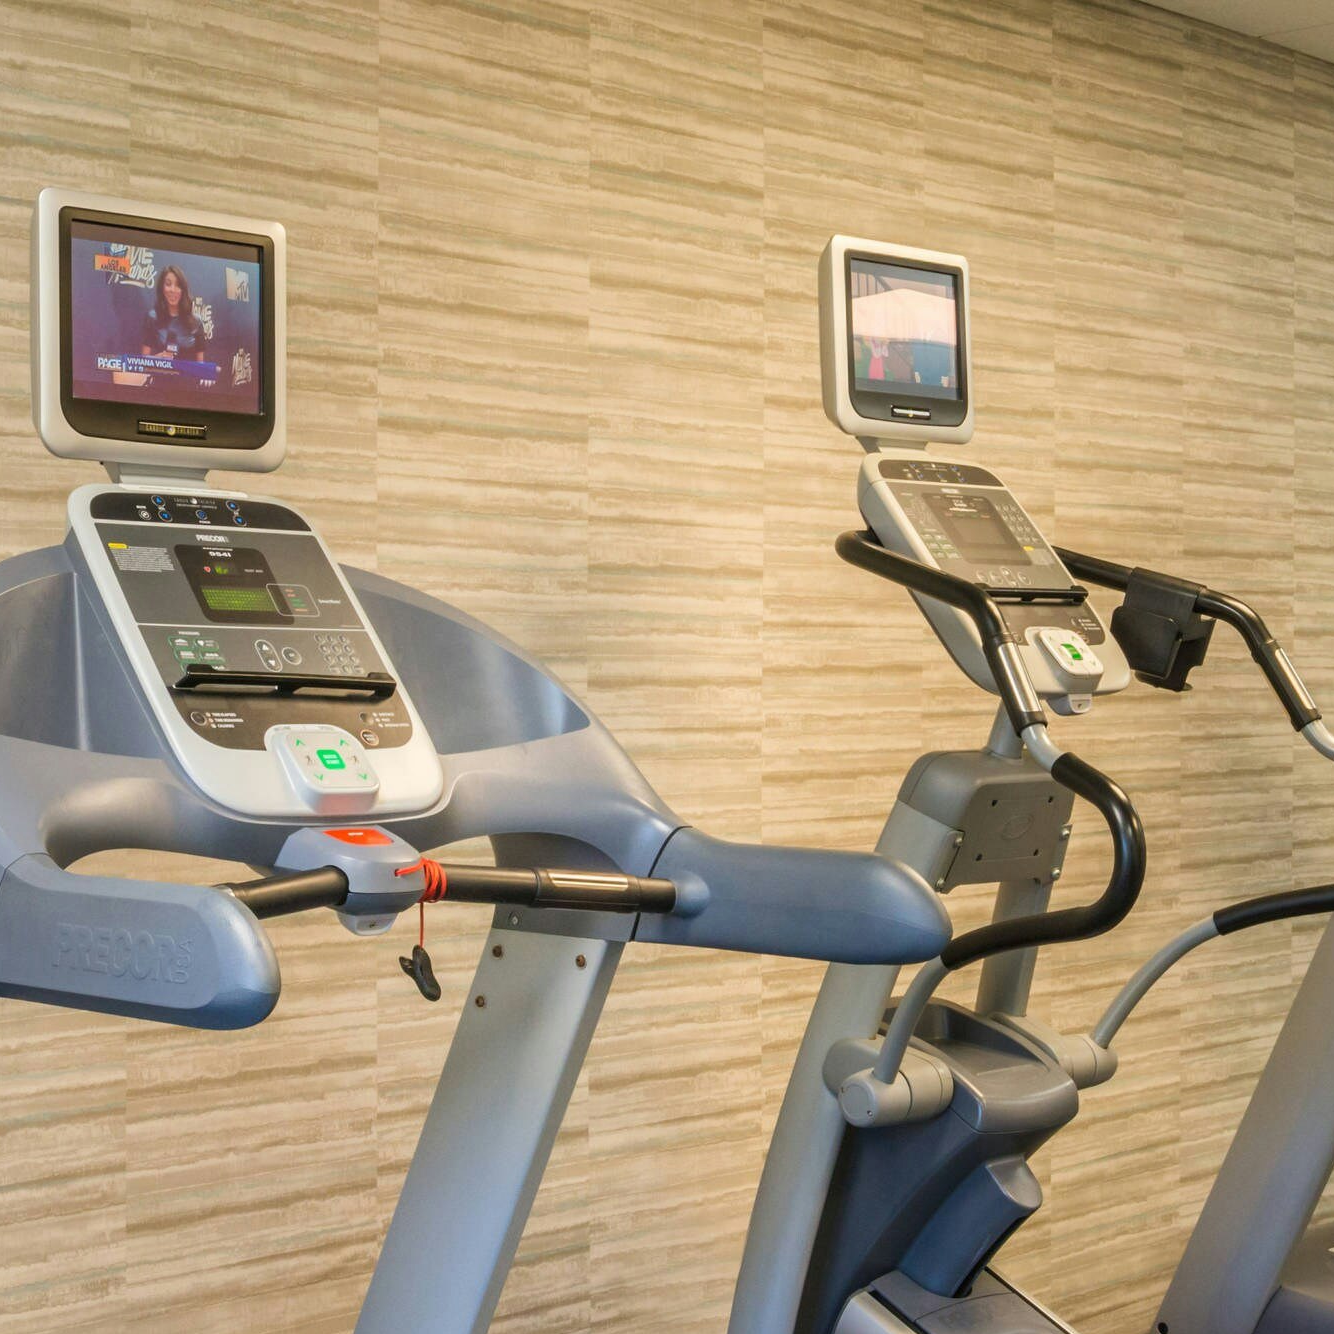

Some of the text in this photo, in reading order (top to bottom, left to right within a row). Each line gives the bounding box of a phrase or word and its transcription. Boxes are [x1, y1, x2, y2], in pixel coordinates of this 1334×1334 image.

[97, 357, 122, 368] PAGE
[127, 357, 174, 369] VIVIANA VIGIL
